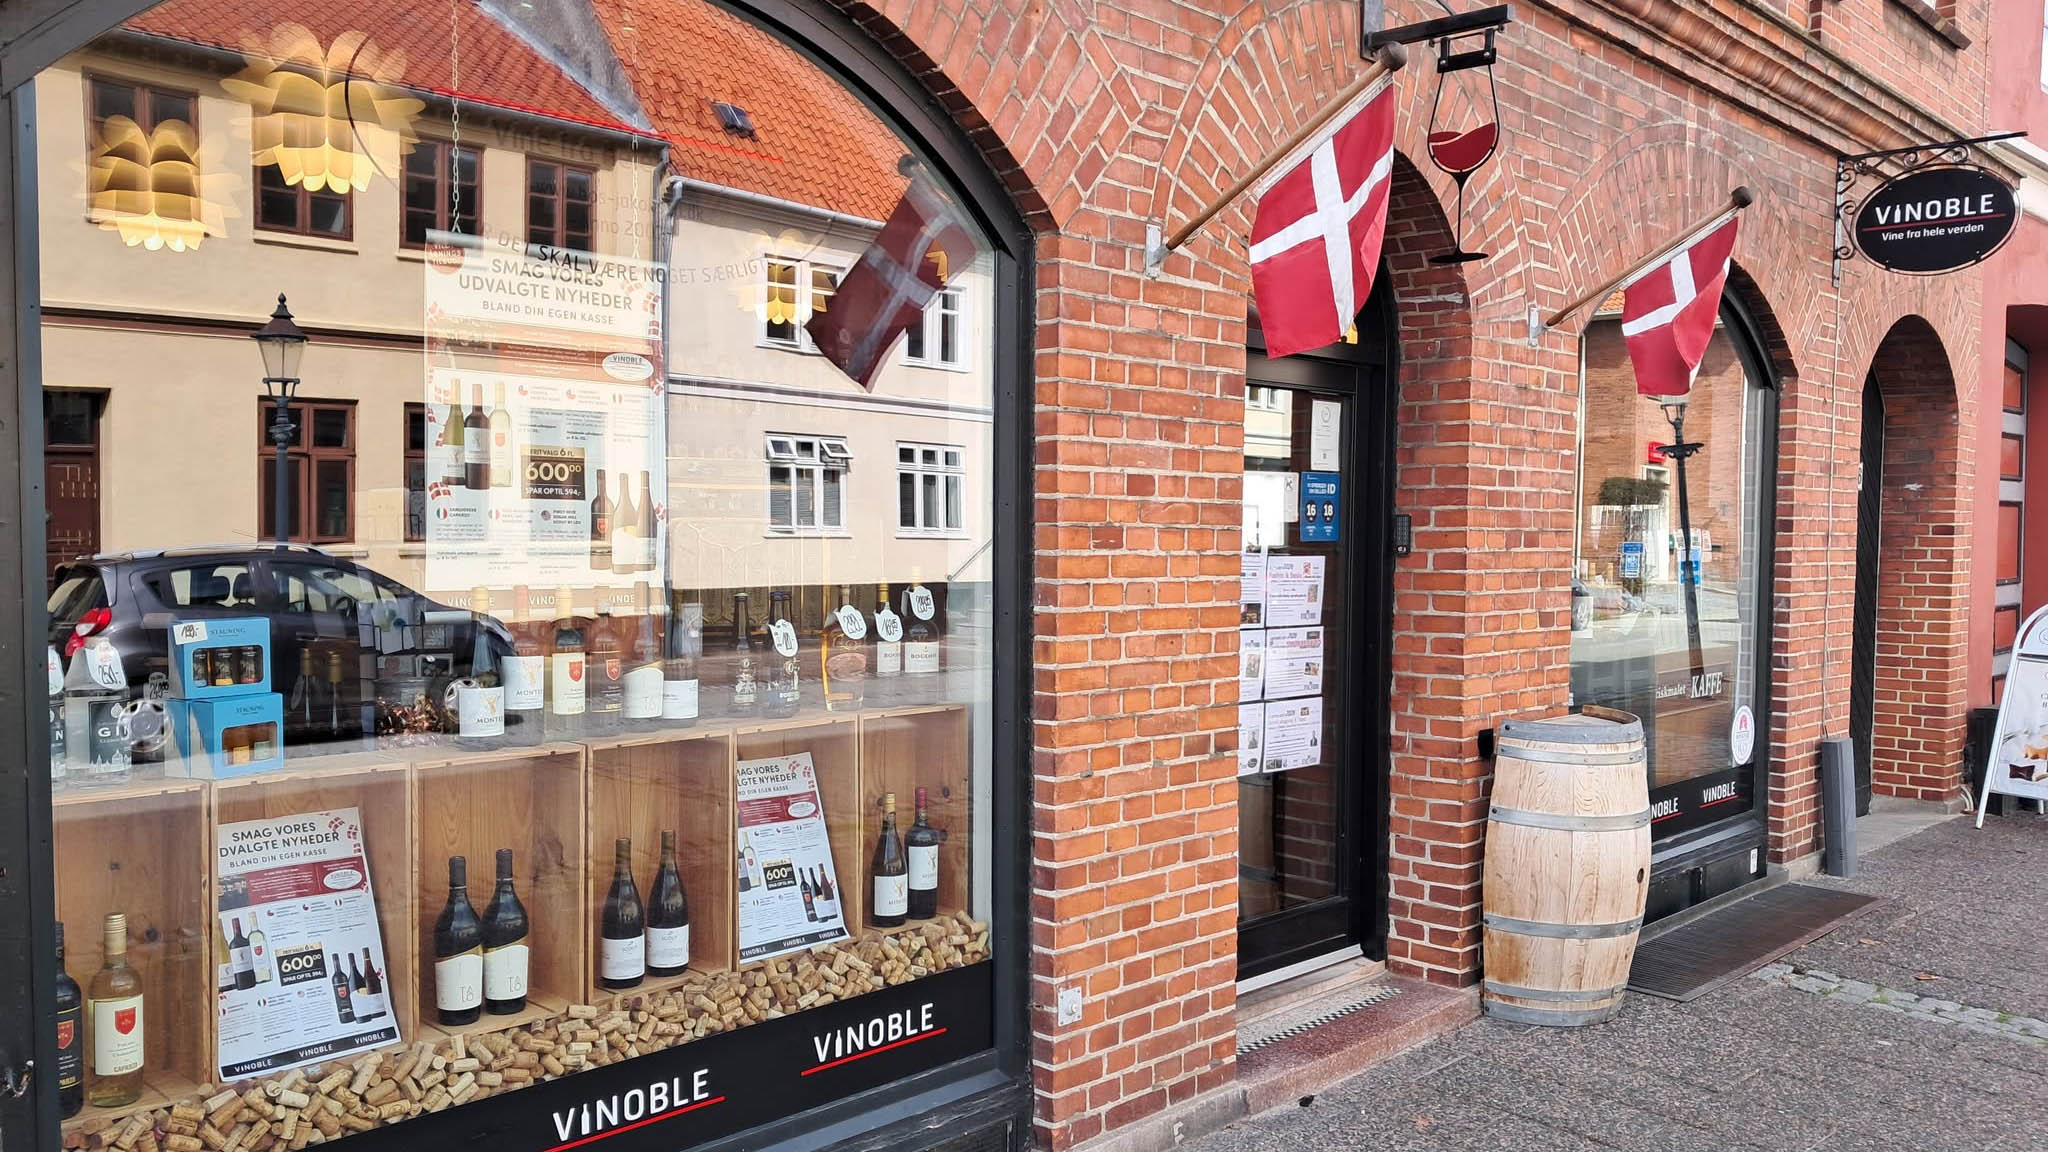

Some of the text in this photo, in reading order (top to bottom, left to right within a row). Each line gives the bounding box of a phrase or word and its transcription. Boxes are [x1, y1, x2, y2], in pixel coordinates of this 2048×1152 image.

[1875, 193, 1994, 225] VINOBLE
[1881, 223, 1984, 241] Vine fra hele verden
[492, 258, 605, 288] SMAG VORES
[538, 245, 582, 272] SKAL
[588, 255, 640, 281] VÆRE
[643, 265, 696, 284] NOGET
[702, 257, 767, 282] SÆRLIGT
[458, 272, 632, 311] UDVALGTE NYHEDER
[482, 300, 614, 326] BLAND DIN EGEN KASSE
[560, 448, 566, 456] 6
[526, 462, 569, 481] 600
[1327, 483, 1336, 494] ID
[1306, 503, 1334, 517] 16 18
[515, 688, 544, 697] MONTE
[1656, 671, 1723, 699] riskmalet KAFFE
[476, 715, 504, 724] MONTE
[753, 765, 780, 775] VORES
[760, 772, 797, 784] NYHEDER
[1651, 781, 1736, 819] NOBLE VINOBLE
[232, 821, 317, 843] SMAG VORES
[219, 832, 340, 858] DVALGTE NYHEDER
[230, 857, 259, 869] BLAND
[280, 851, 301, 860] EGEN
[303, 847, 328, 857] KASSE
[767, 867, 788, 881] 600
[281, 955, 314, 973] 600
[813, 1001, 935, 1064] VINOBLE
[235, 1031, 387, 1073] VINOBLE VINOBLE VINOBLE
[552, 1068, 710, 1142] VINOBLE
